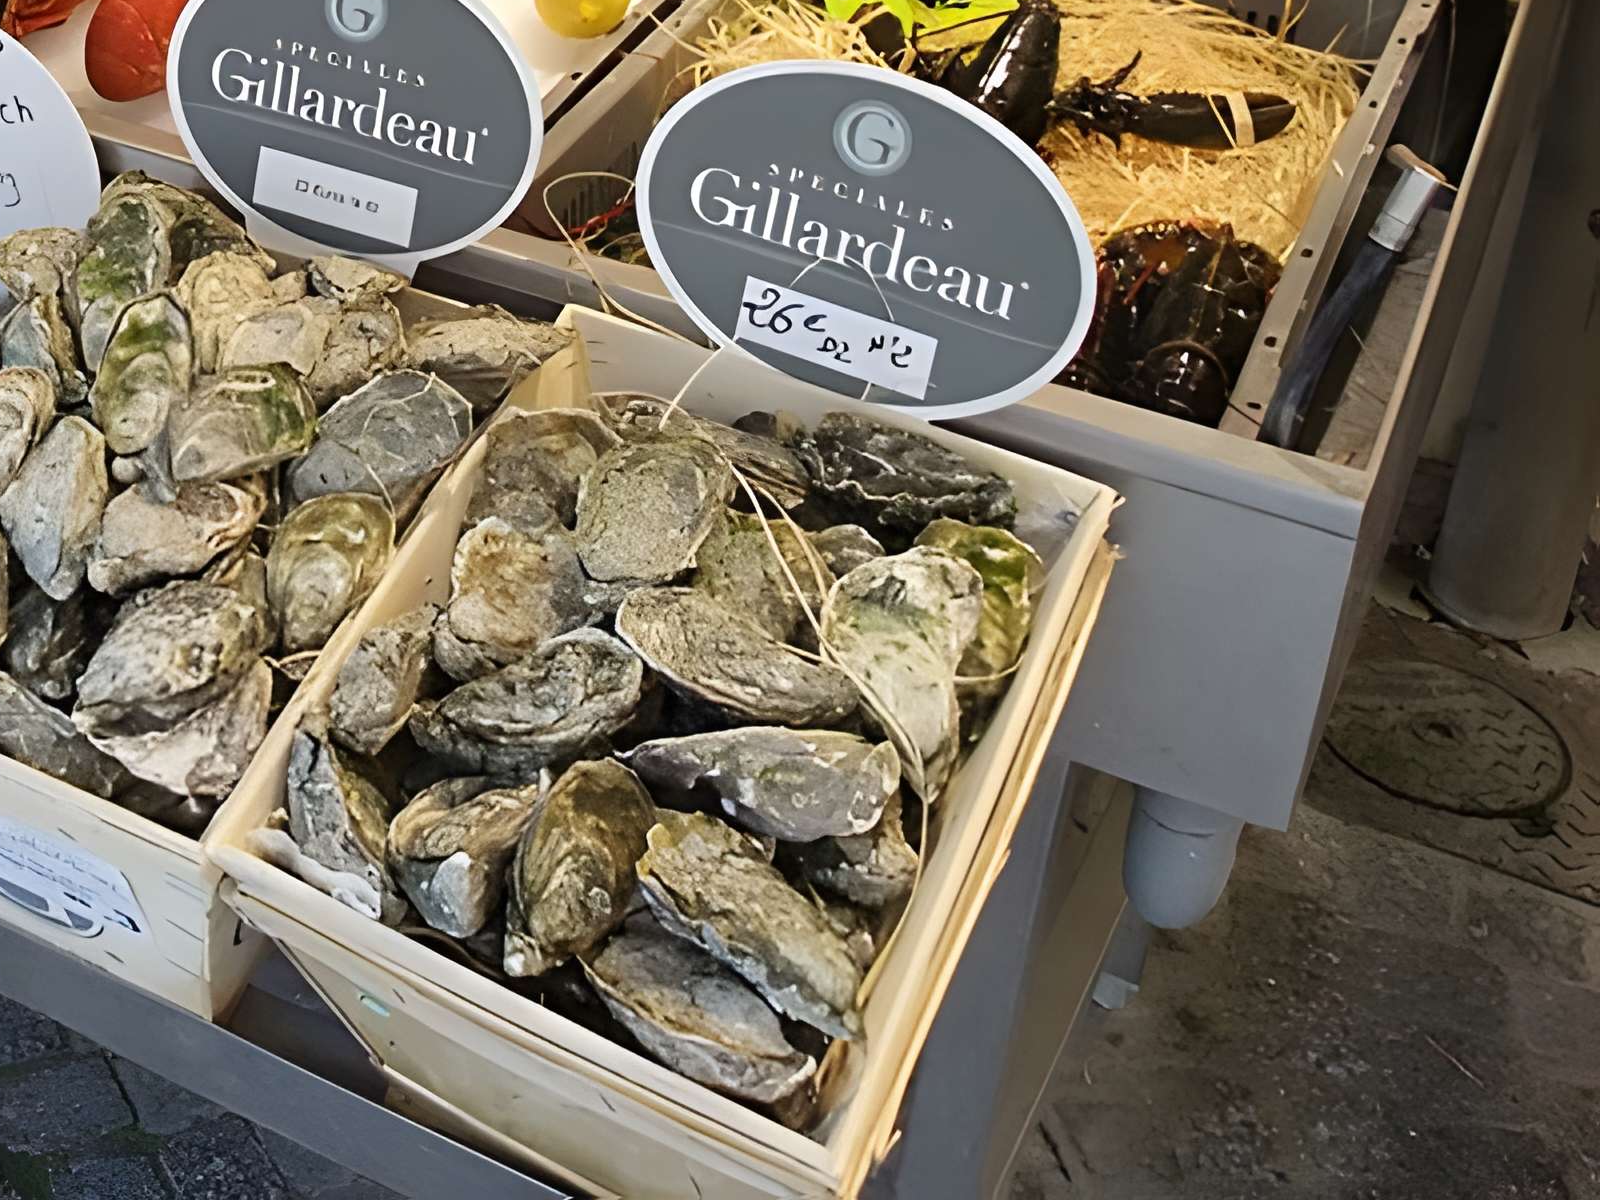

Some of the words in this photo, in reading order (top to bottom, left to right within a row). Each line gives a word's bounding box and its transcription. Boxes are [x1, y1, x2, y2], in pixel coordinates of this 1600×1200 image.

[211, 48, 478, 166] Gillardeau
[846, 110, 896, 166] G
[690, 167, 1022, 321] Gillardeau
